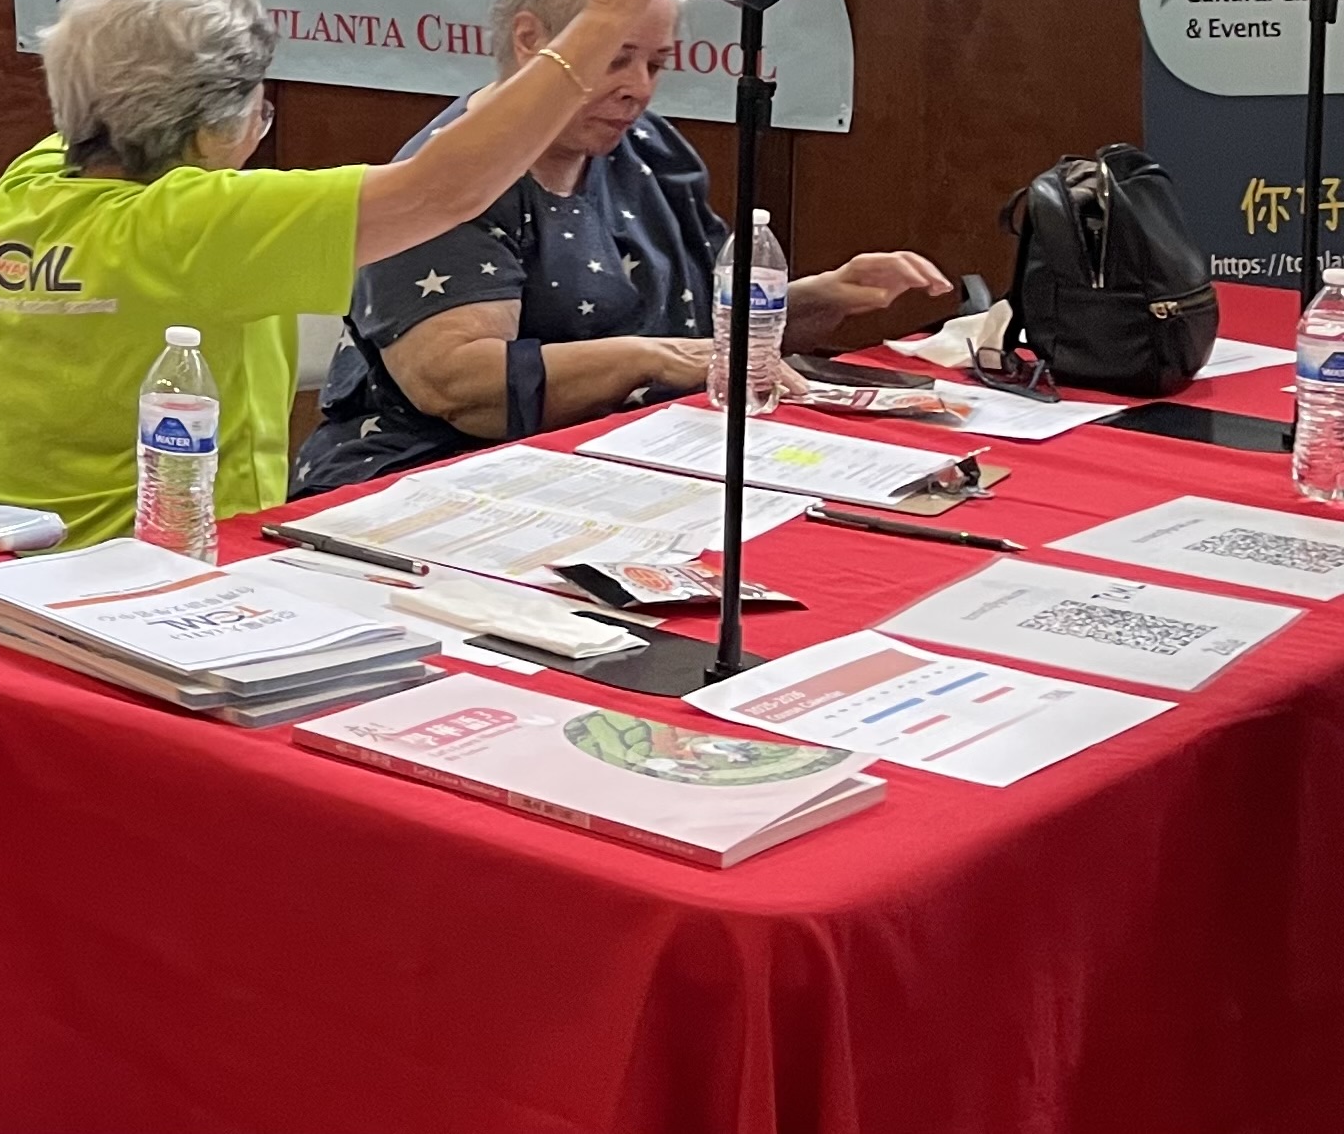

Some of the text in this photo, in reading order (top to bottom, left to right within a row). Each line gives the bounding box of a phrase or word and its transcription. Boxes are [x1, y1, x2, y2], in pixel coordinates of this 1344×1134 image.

[267, 8, 406, 49] TLANTA
[1186, 17, 1282, 39] & Events
[155, 434, 191, 447] WATER
[146, 604, 272, 630] TCML
